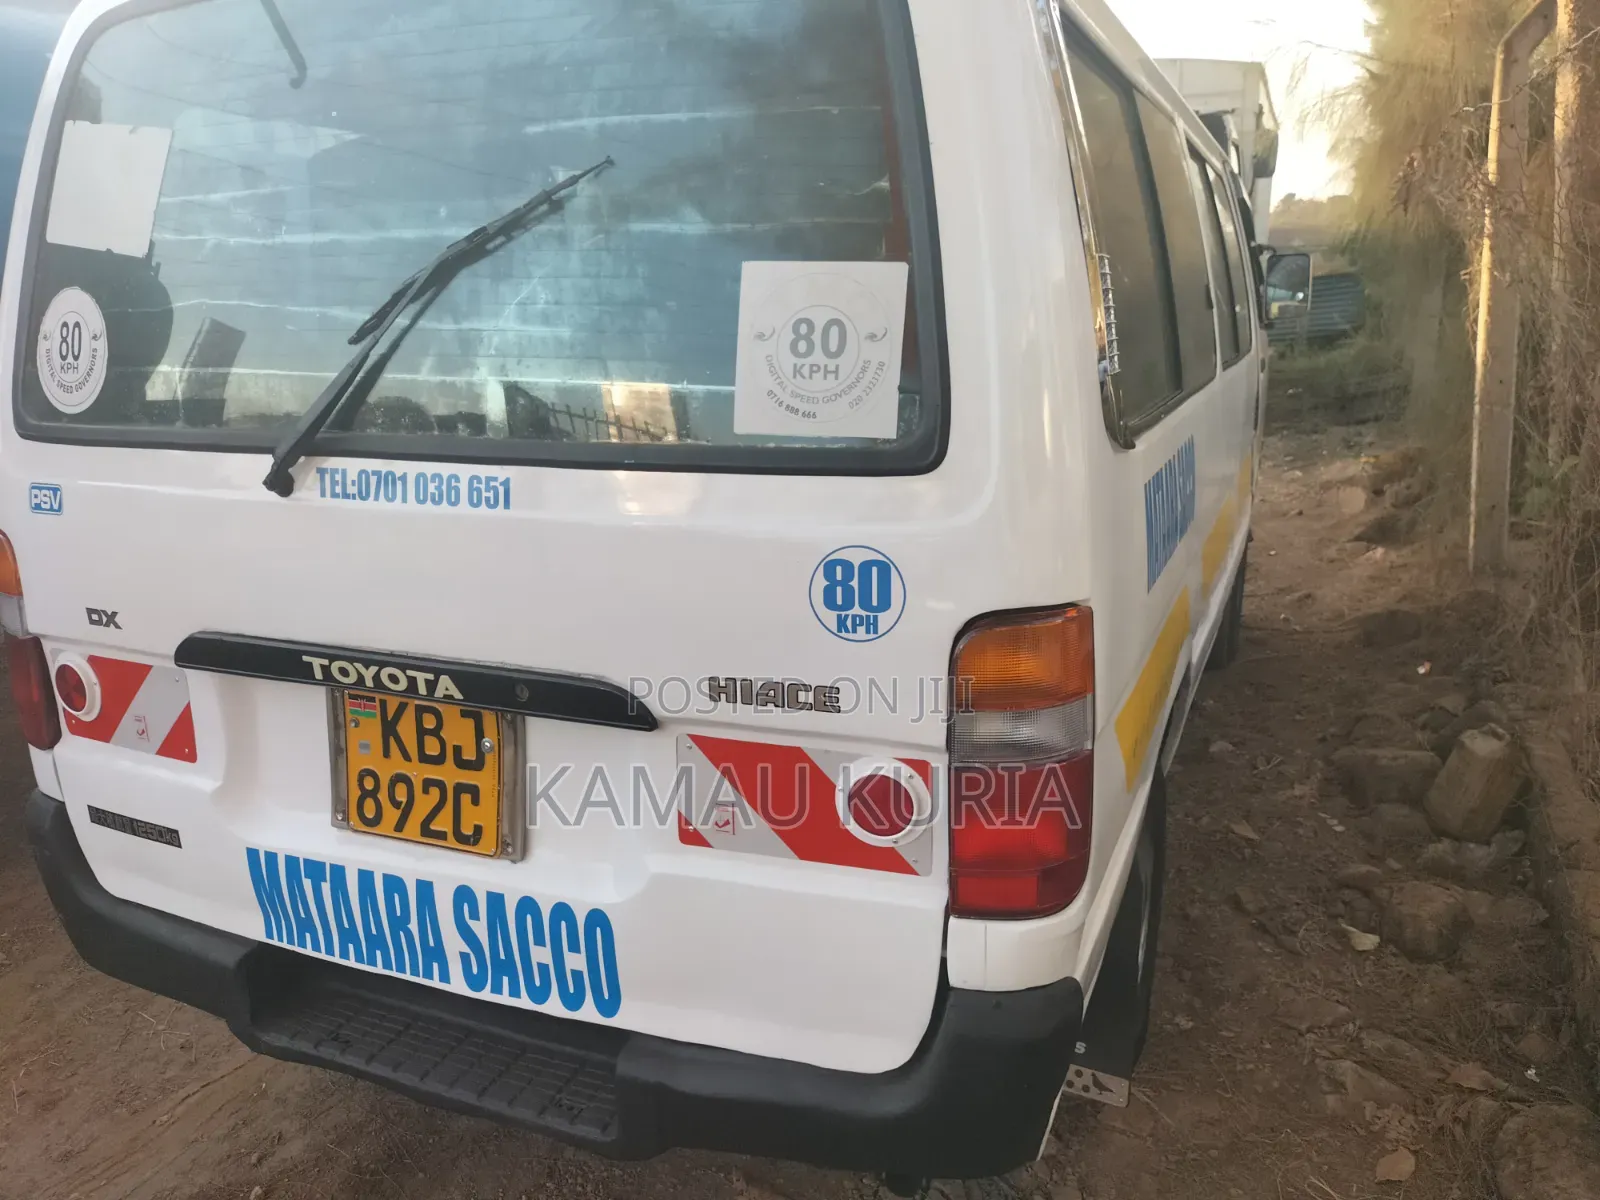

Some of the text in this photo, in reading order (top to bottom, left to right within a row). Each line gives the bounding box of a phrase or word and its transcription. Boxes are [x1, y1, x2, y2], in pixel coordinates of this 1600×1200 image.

[59, 320, 82, 362] 80
[789, 317, 847, 360] 80
[45, 347, 98, 394] DIGITAL SPEED GOVERNORS
[60, 361, 79, 374] KPH
[765, 354, 872, 405] DIGITAL SPEED GOVERNORS
[792, 363, 840, 381] KPH
[766, 389, 817, 419] 0716 888 666
[31, 488, 61, 510] PSV
[316, 466, 511, 510] TEL:0701 036 651
[822, 558, 892, 614] 80
[85, 607, 123, 630] DX
[836, 613, 879, 635] KPH
[301, 655, 464, 700] TOYOTA
[708, 676, 841, 713] HIACE
[378, 698, 486, 772] KBJ
[356, 767, 484, 847] 892C
[246, 846, 622, 1019] MATAARA SACCO
